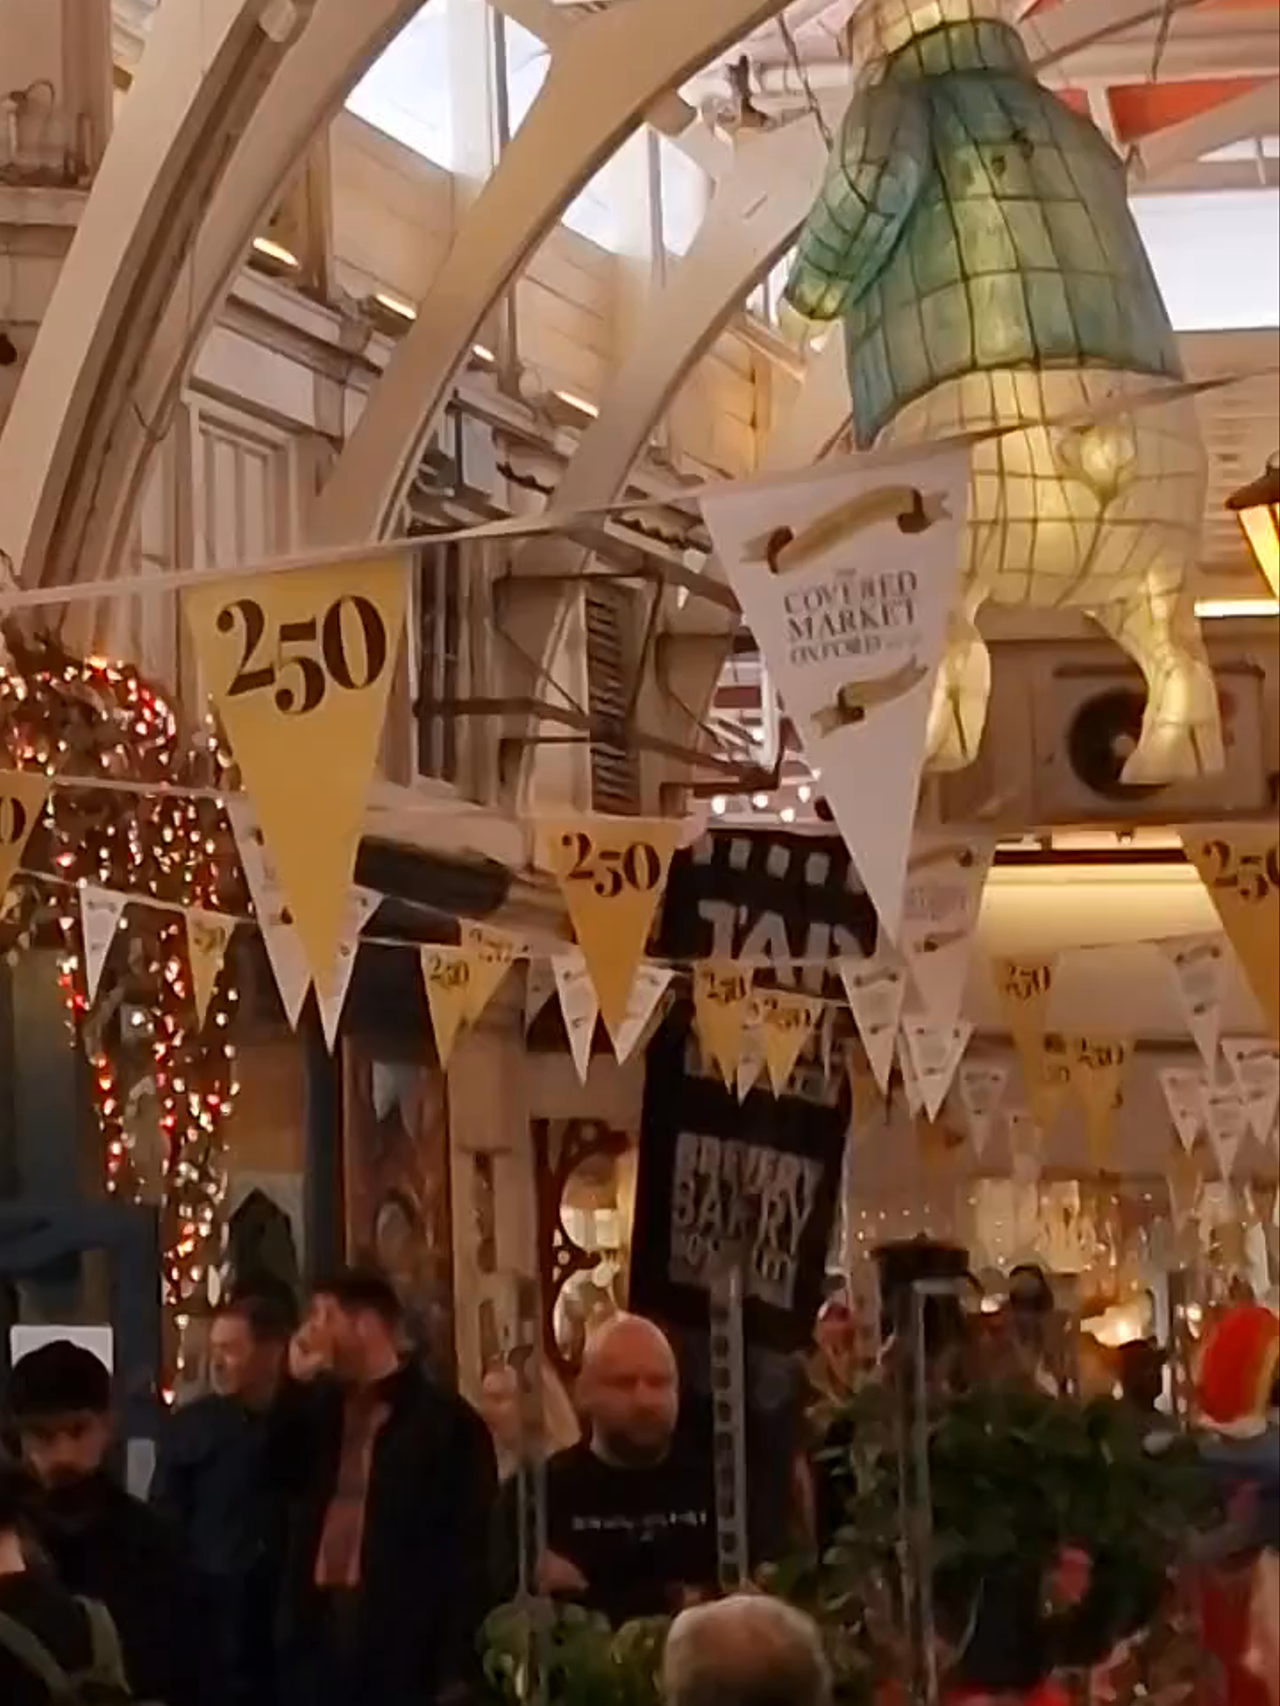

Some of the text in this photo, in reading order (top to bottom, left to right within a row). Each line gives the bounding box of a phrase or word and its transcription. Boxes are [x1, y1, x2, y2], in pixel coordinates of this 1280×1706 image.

[788, 598, 914, 642] MARKET
[216, 594, 388, 715] 250
[561, 832, 661, 898] 250
